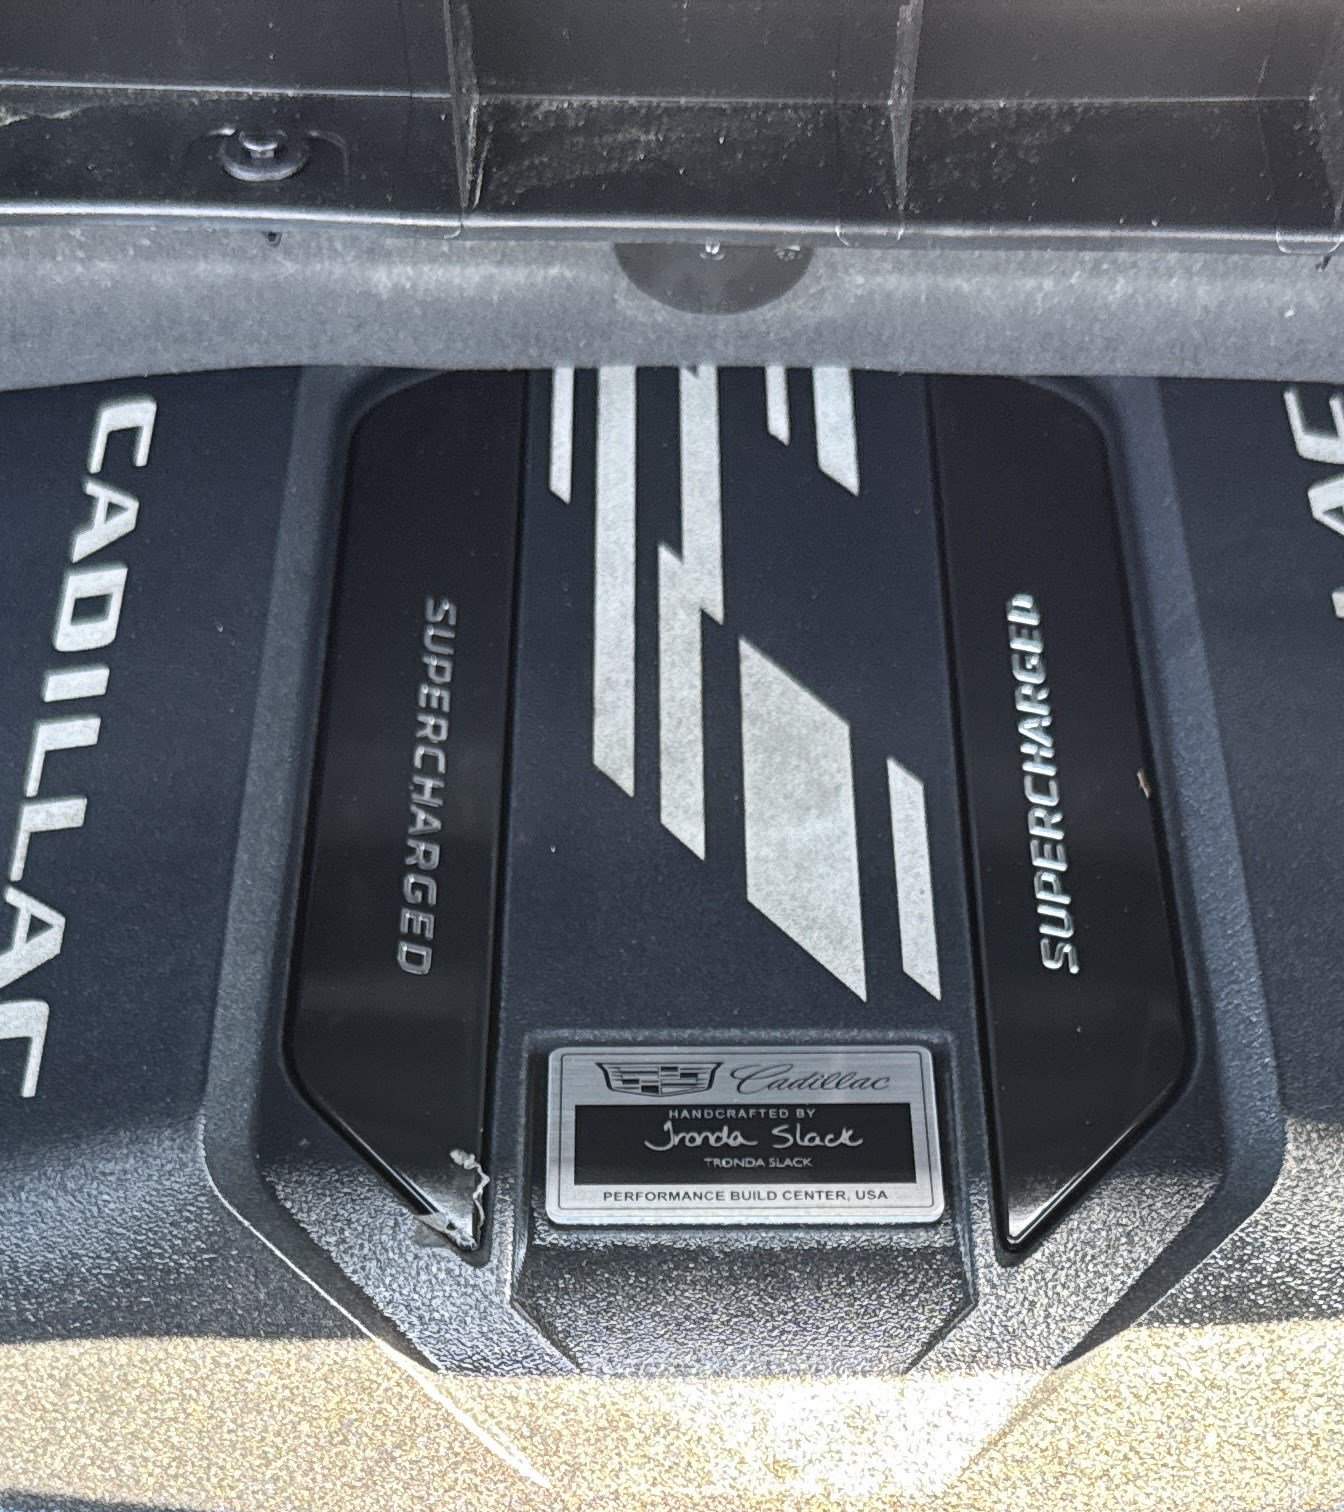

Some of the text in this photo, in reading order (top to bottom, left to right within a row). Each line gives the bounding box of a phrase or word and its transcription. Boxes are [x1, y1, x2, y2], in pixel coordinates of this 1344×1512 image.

[396, 596, 458, 976] SUPERCHARGED
[1005, 592, 1082, 976] SUPERCHARGED
[729, 1063, 891, 1095] Cadillac
[668, 1108, 817, 1120] HANDCRAFTED BY
[770, 1122, 865, 1149] Slack
[704, 1157, 813, 1169] TRONDA SLACK
[603, 1189, 889, 1202] PERFORMANCE BUILD CENTER, USA
